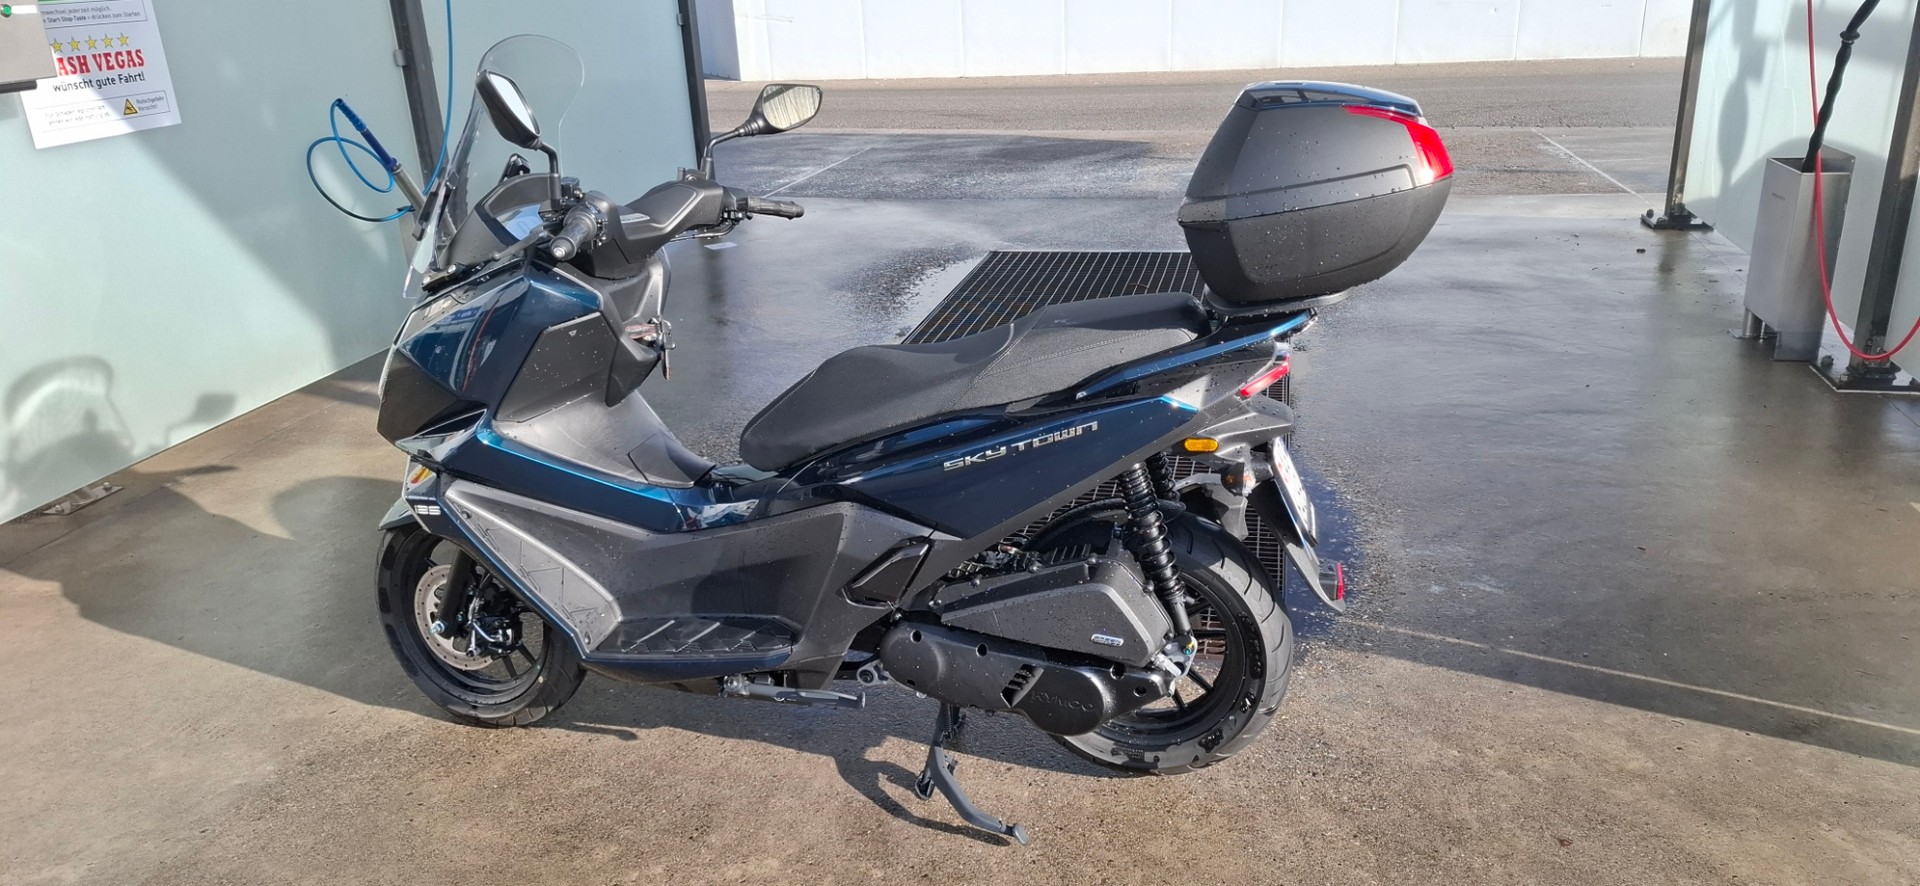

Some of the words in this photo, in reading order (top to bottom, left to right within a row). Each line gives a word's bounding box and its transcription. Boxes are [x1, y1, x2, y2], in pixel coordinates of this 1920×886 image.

[56, 55, 91, 76] ASH
[92, 49, 145, 71] VEGAS
[53, 79, 93, 92] wünscht
[95, 76, 116, 89] gute
[118, 71, 145, 84] Fahrt!
